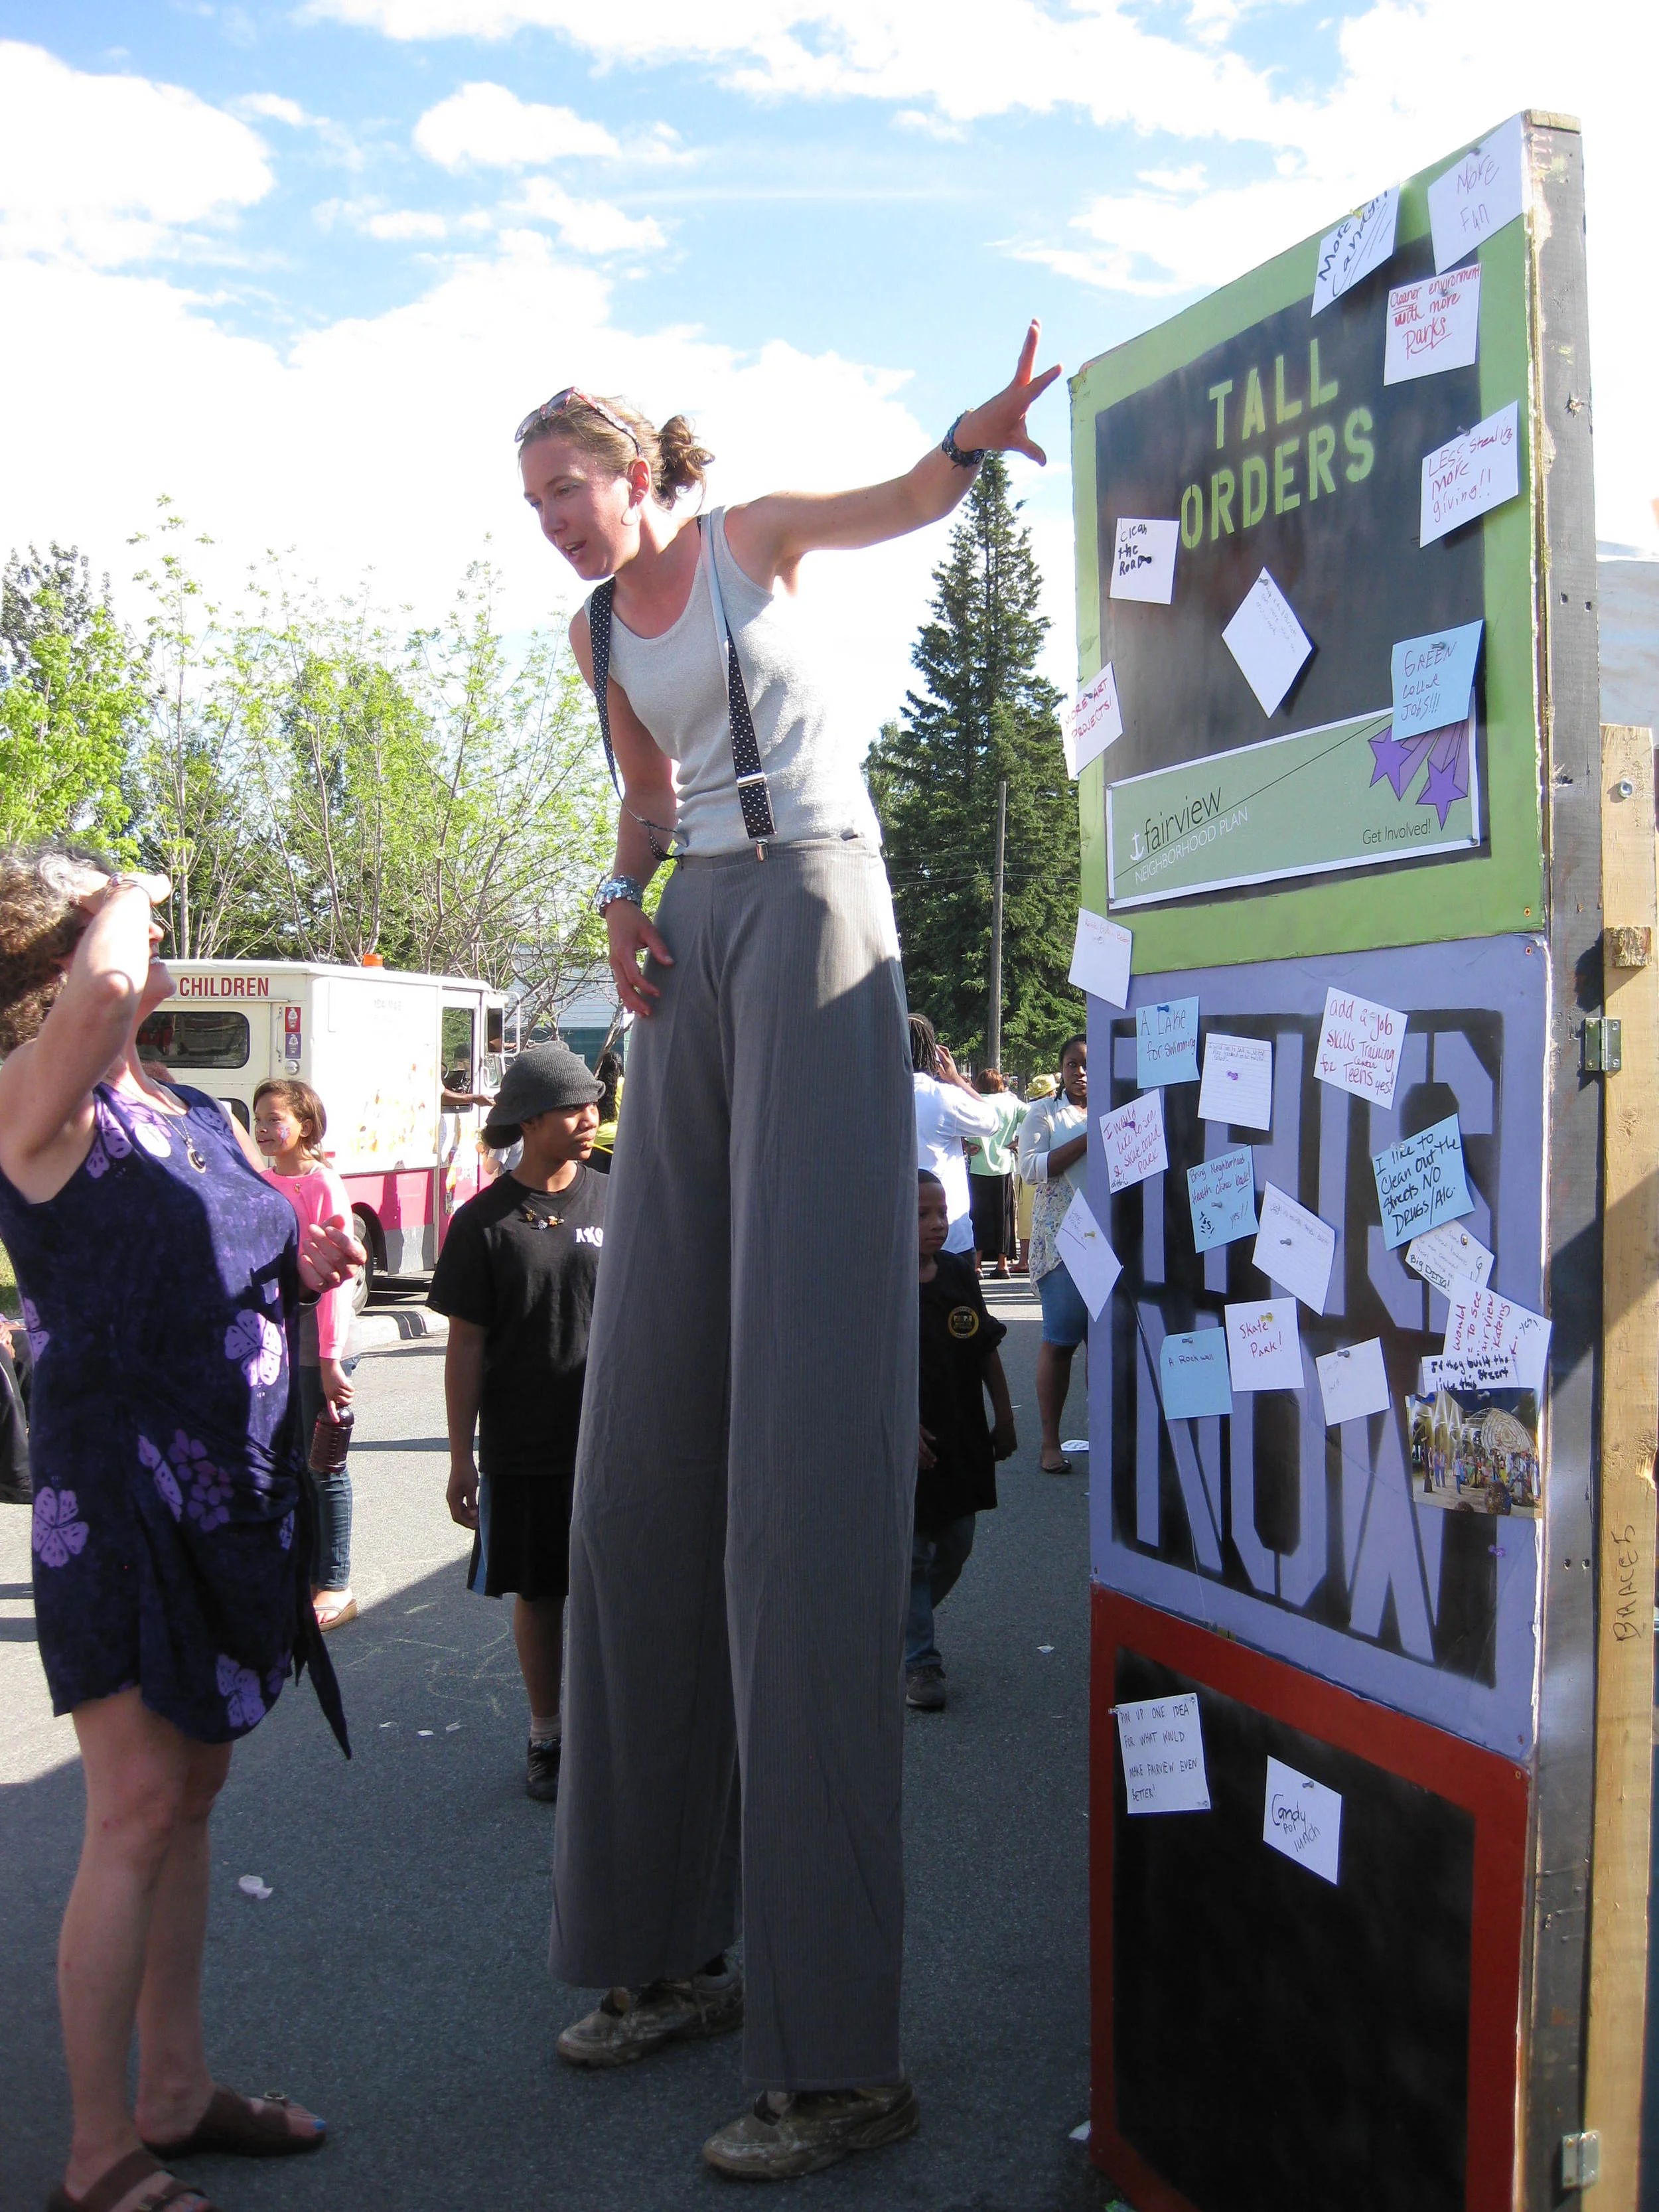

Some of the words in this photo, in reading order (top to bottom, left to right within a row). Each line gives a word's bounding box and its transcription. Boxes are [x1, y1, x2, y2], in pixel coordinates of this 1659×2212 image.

[1209, 338, 1338, 450] TALL
[1181, 407, 1374, 550] ORDERS
[1093, 678, 1108, 701] ART
[1145, 786, 1221, 853] fairview
[1362, 829, 1382, 844] Get
[1385, 818, 1431, 841] Involved!
[1135, 825, 1216, 887] NEIGHBORHOOD
[1220, 806, 1248, 836] PLAN
[180, 977, 269, 996] CHILDREN
[1140, 1010, 1150, 1036] A
[1376, 1157, 1386, 1176] I
[1417, 1134, 1433, 1150] to
[1433, 1136, 1461, 1155] the
[1423, 1166, 1441, 1190] NO
[1410, 1254, 1424, 1272] Big
[1120, 1711, 1130, 1724] PIN
[1135, 1708, 1143, 1721] UP
[1151, 1705, 1165, 1719] ONE
[1173, 1704, 1189, 1718] IDEA
[1123, 1734, 1135, 1749] FOR
[1139, 1732, 1157, 1746] WHAT
[1163, 1730, 1185, 1743] WOULD
[1129, 1764, 1143, 1779] MAKE
[1147, 1761, 1174, 1777] FAIRVIEW
[1180, 1757, 1197, 1772] EVEN
